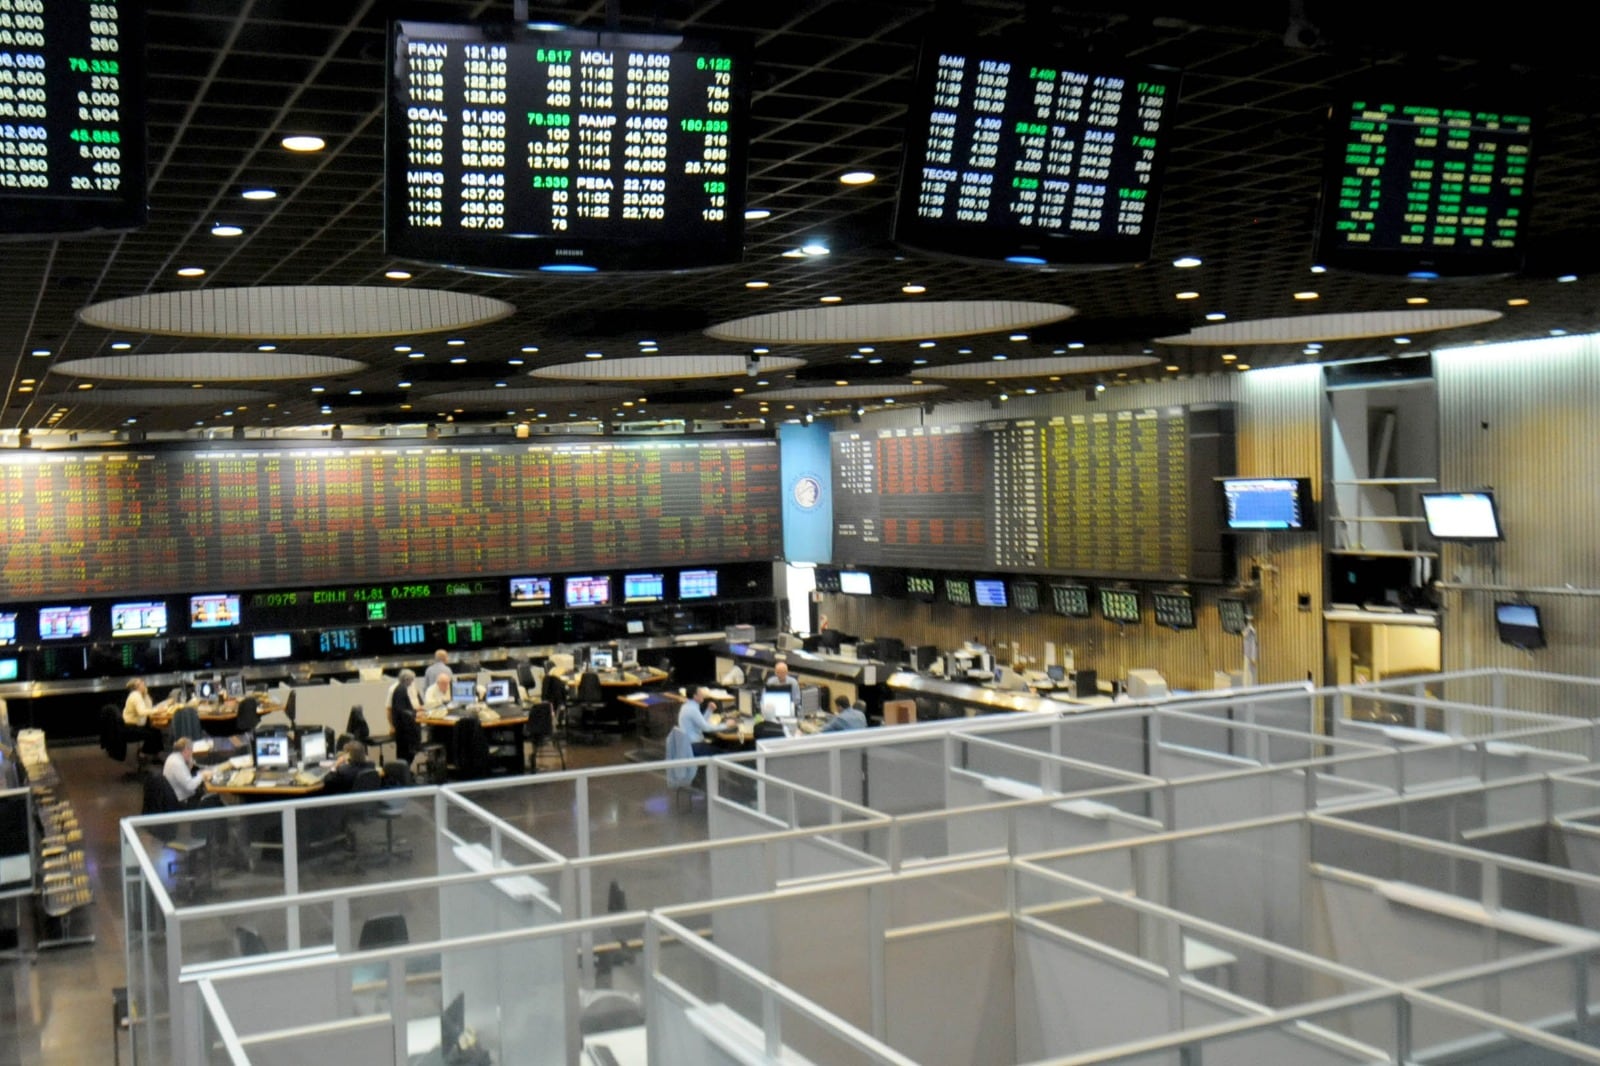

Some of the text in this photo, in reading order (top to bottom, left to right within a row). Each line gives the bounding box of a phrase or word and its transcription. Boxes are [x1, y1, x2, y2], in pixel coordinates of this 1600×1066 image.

[408, 43, 447, 58] FRAN
[580, 49, 614, 66] MOLI
[715, 72, 730, 85] 70
[546, 93, 571, 107] 400
[580, 94, 613, 109] 11:44
[707, 100, 729, 114] 100
[407, 107, 448, 122] GGAL
[578, 113, 617, 128] PAMP
[408, 122, 443, 136] 11:40
[547, 128, 570, 141] 100
[579, 129, 612, 143] 11:40
[408, 137, 443, 150] 11:40
[578, 143, 610, 157] 11:41
[408, 151, 443, 165] 11:40
[407, 171, 444, 185] MIRG
[576, 176, 614, 190] PESA
[704, 181, 725, 193] 123
[461, 187, 505, 201] 437,00
[552, 204, 568, 217] 70
[408, 215, 442, 227] 11:44
[460, 216, 504, 229] 437,00
